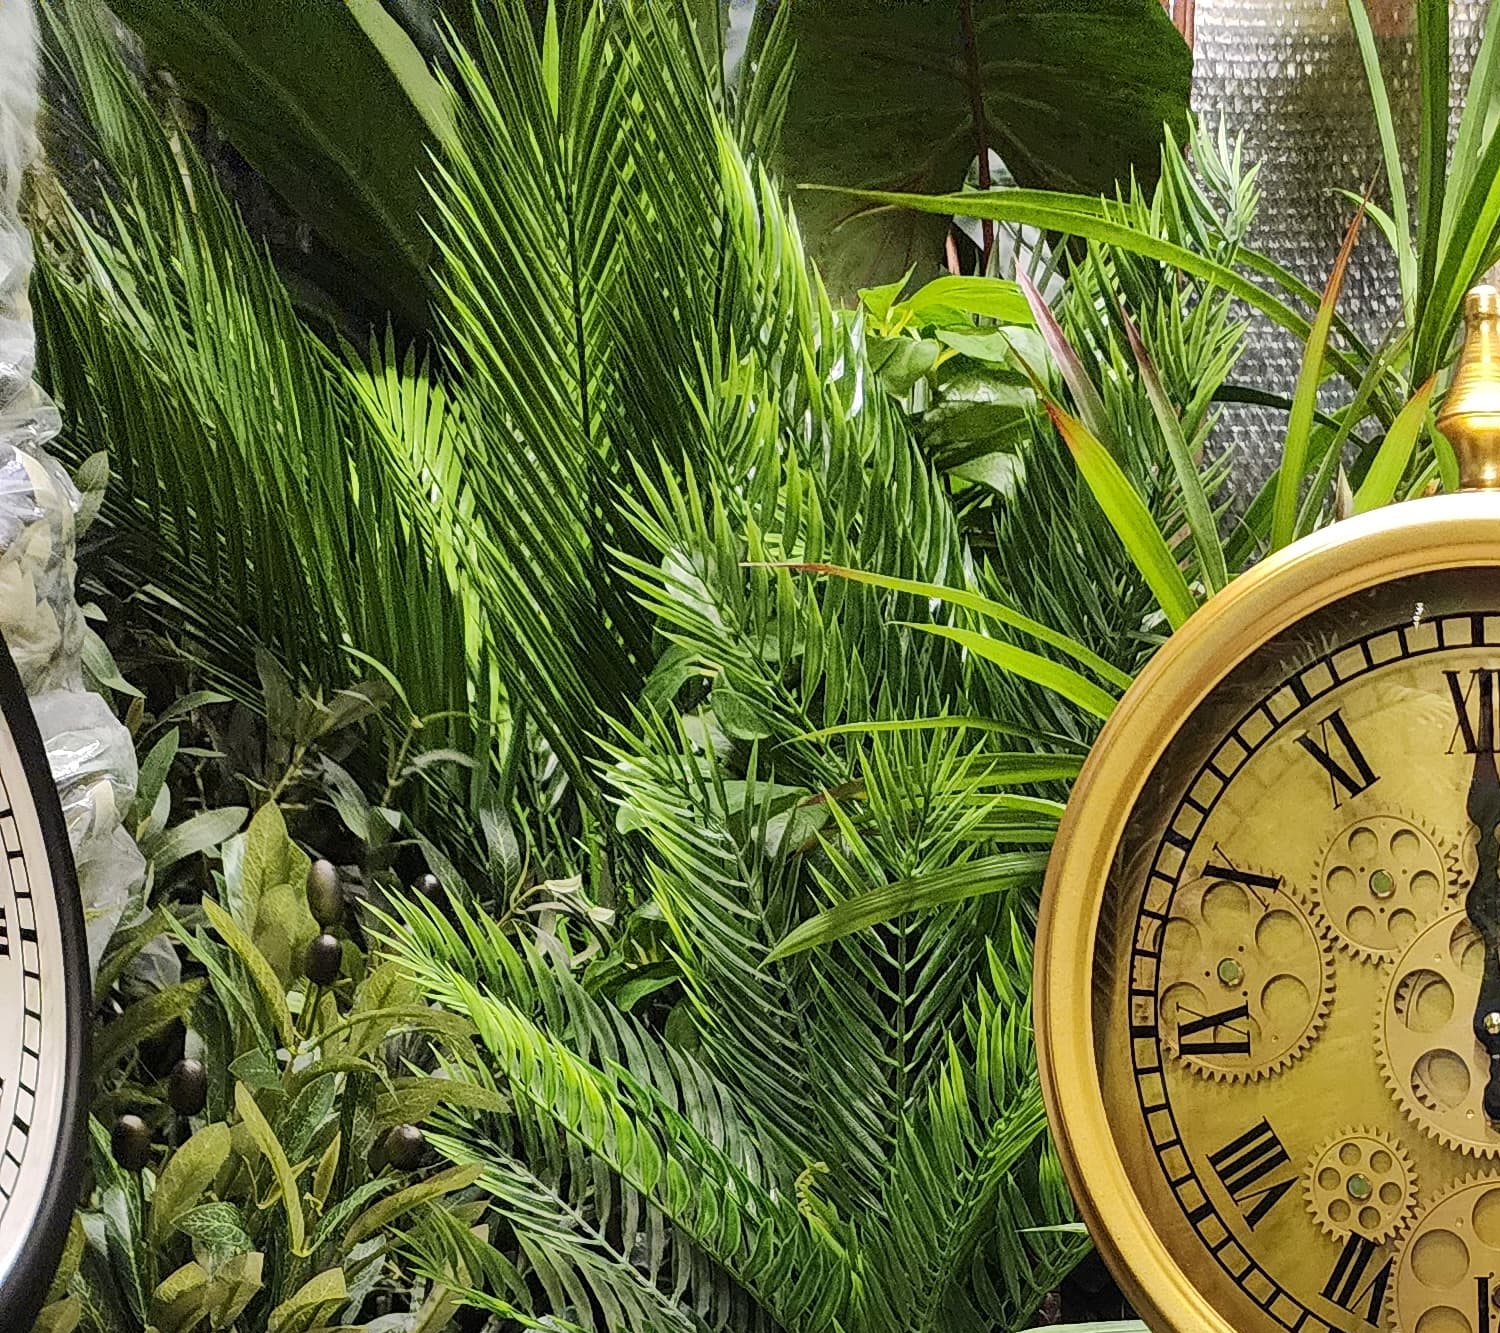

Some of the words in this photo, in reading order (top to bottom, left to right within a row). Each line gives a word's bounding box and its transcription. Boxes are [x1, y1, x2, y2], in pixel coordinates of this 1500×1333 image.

[1293, 707, 1381, 810] XI
[1202, 841, 1285, 912] X
[1176, 1000, 1252, 1058] IX
[1206, 1115, 1299, 1232] VIII
[1318, 1229, 1395, 1328] VII
